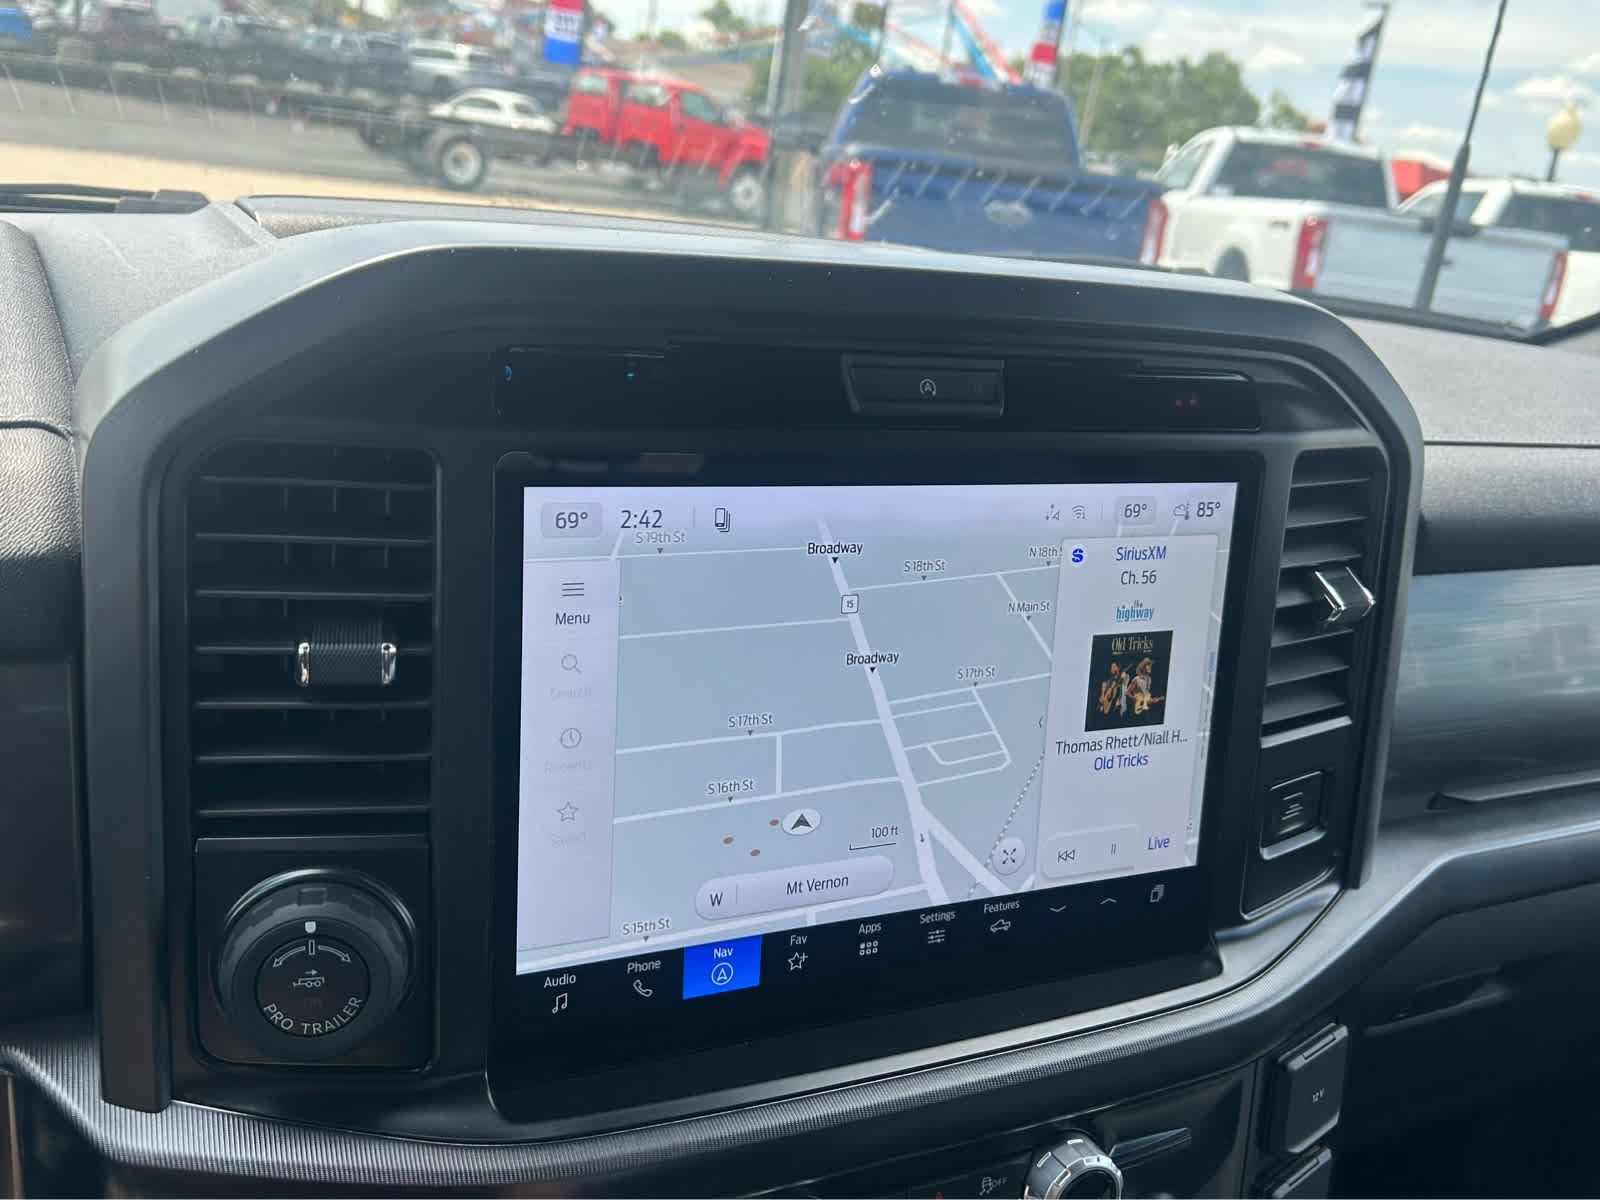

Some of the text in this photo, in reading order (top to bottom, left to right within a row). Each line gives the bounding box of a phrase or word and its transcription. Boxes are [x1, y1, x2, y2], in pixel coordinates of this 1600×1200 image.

[1123, 503, 1147, 518] 69°
[1196, 502, 1221, 518] 85°
[555, 511, 589, 529] 69°
[620, 509, 663, 529] 2:42
[636, 531, 686, 544] S 19th St
[807, 541, 863, 556] Broadway
[1030, 546, 1037, 557] N
[1039, 546, 1058, 558] 18th
[1116, 545, 1167, 562] SiriusXM
[904, 560, 945, 572] S 18th St
[1120, 569, 1157, 586] Ch. 56
[846, 600, 854, 609] 15
[1008, 601, 1050, 613] N Main St
[555, 612, 591, 626] Menu
[1116, 606, 1154, 622] highway
[1128, 635, 1153, 651] Tricks
[846, 651, 900, 666] Broadway
[958, 666, 996, 679] S 17th St
[728, 714, 773, 728] S 17th St
[1056, 738, 1103, 756] Thomas
[1105, 730, 1169, 750] Rhett/Niall
[1094, 753, 1149, 771] Old Tricks
[708, 780, 754, 795] S 16th St
[871, 825, 899, 839] 100 ft
[1148, 837, 1170, 850] Live
[786, 875, 849, 895] Mt Vernon
[709, 892, 723, 908] W
[983, 900, 1021, 913] Features
[919, 909, 956, 925] Settings
[623, 918, 671, 936] S 15th St
[858, 922, 882, 935] Apps
[790, 934, 808, 946] Fav
[713, 946, 734, 959] Nav
[627, 958, 662, 973] Phone
[543, 973, 577, 988] Audio
[263, 996, 363, 1035] PRO TRAILER
